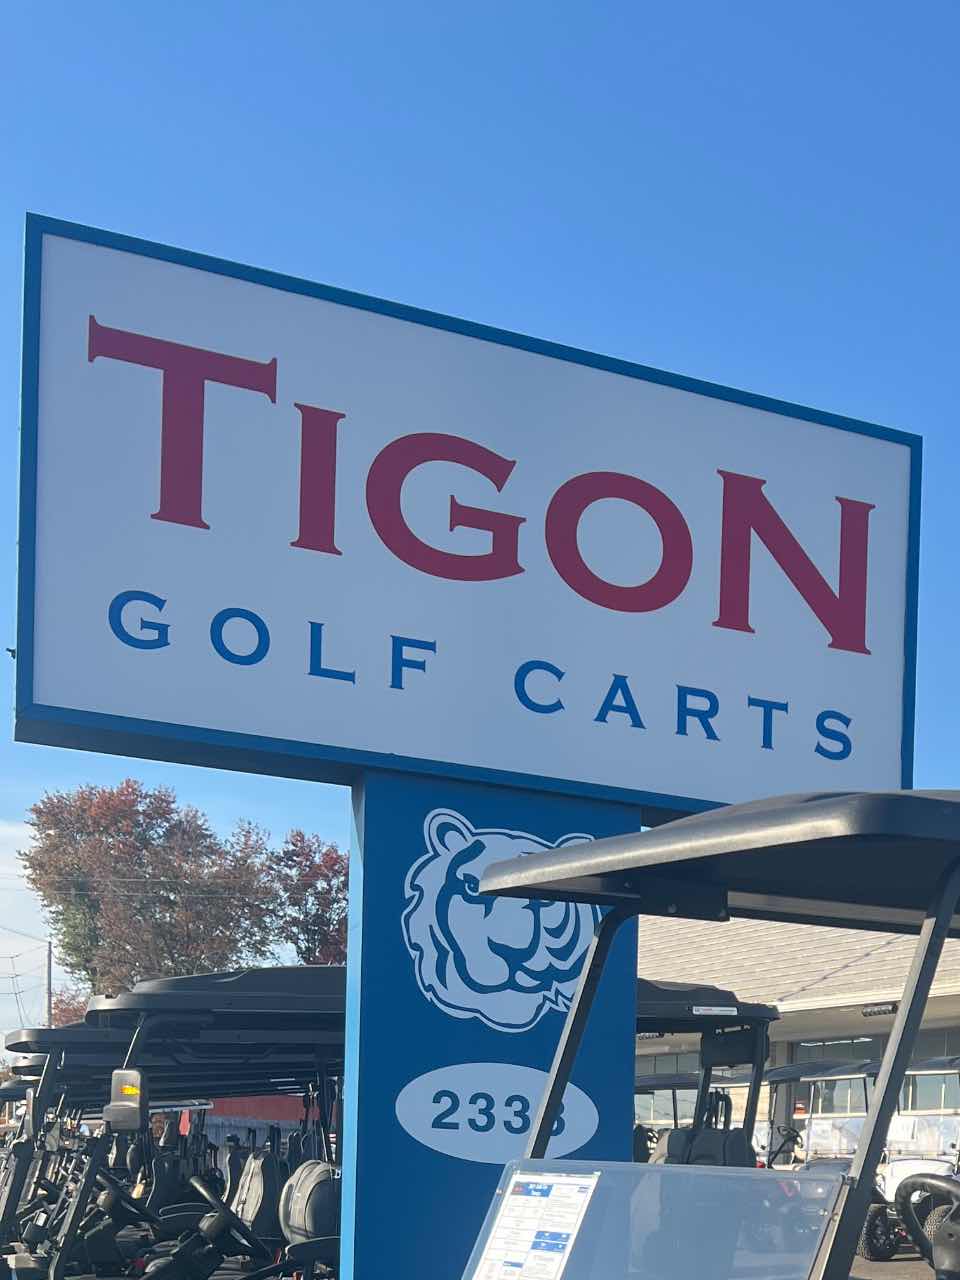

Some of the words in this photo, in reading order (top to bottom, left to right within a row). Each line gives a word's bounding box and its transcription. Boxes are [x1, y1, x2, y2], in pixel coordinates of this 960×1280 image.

[87, 314, 876, 655] TIGON
[108, 589, 437, 690] GOLF
[513, 659, 854, 762] CARTS
